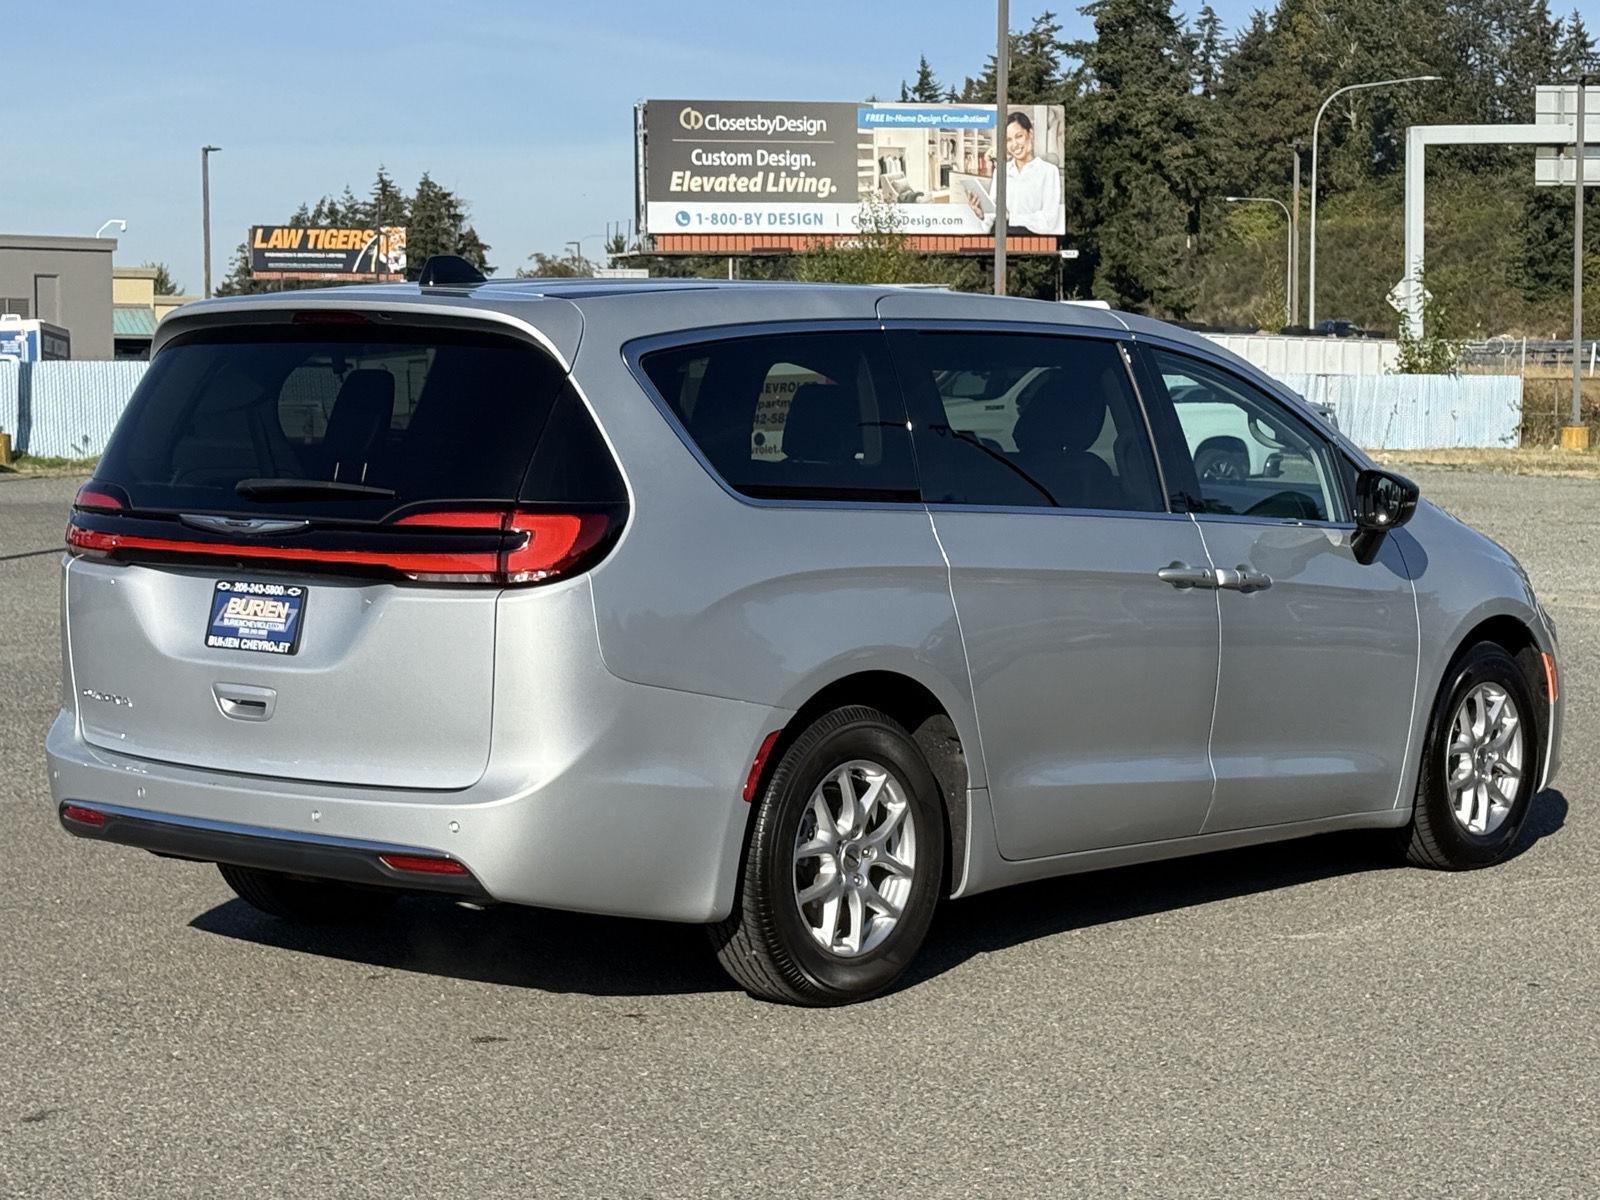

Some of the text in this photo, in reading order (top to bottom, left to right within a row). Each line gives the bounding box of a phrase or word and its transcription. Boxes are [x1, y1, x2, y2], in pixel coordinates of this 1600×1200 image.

[704, 113, 827, 136] ClosetsbyDesign
[865, 112, 990, 125] FREE In-Home Design Consultation!
[691, 149, 816, 170] Custom Design.
[669, 170, 837, 198] Elevated Living.
[696, 212, 823, 226] 1-800-BY DESIGN
[253, 227, 375, 250] LAW TIGERS
[234, 582, 284, 595] 206-243-5800
[227, 597, 290, 618] BURIEN
